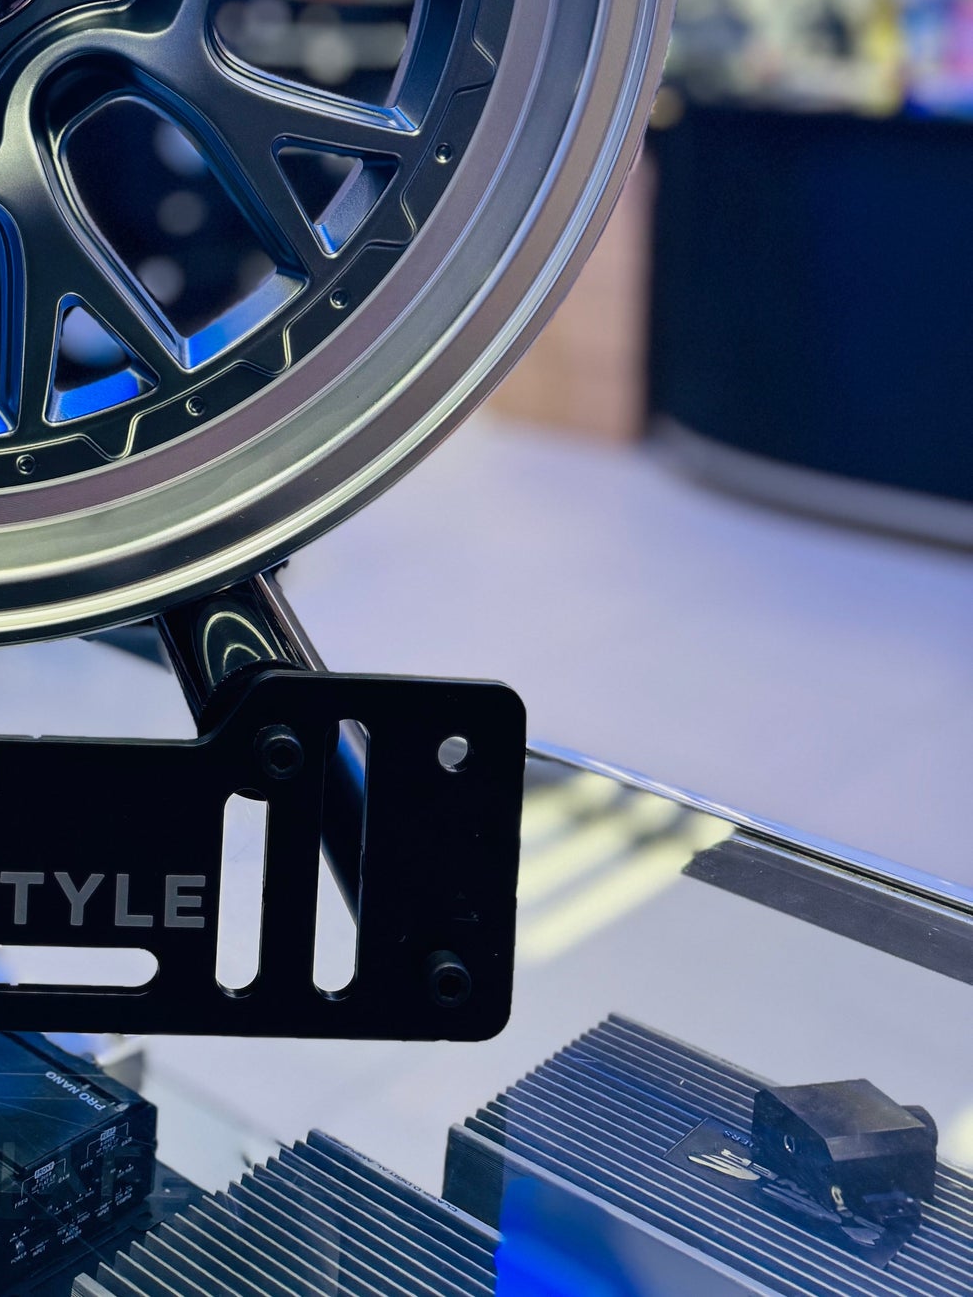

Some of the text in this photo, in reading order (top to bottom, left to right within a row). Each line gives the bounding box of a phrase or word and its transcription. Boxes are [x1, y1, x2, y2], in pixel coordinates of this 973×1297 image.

[44, 1069, 107, 1112] PRO NANO
[35, 1162, 55, 1179] FRONT
